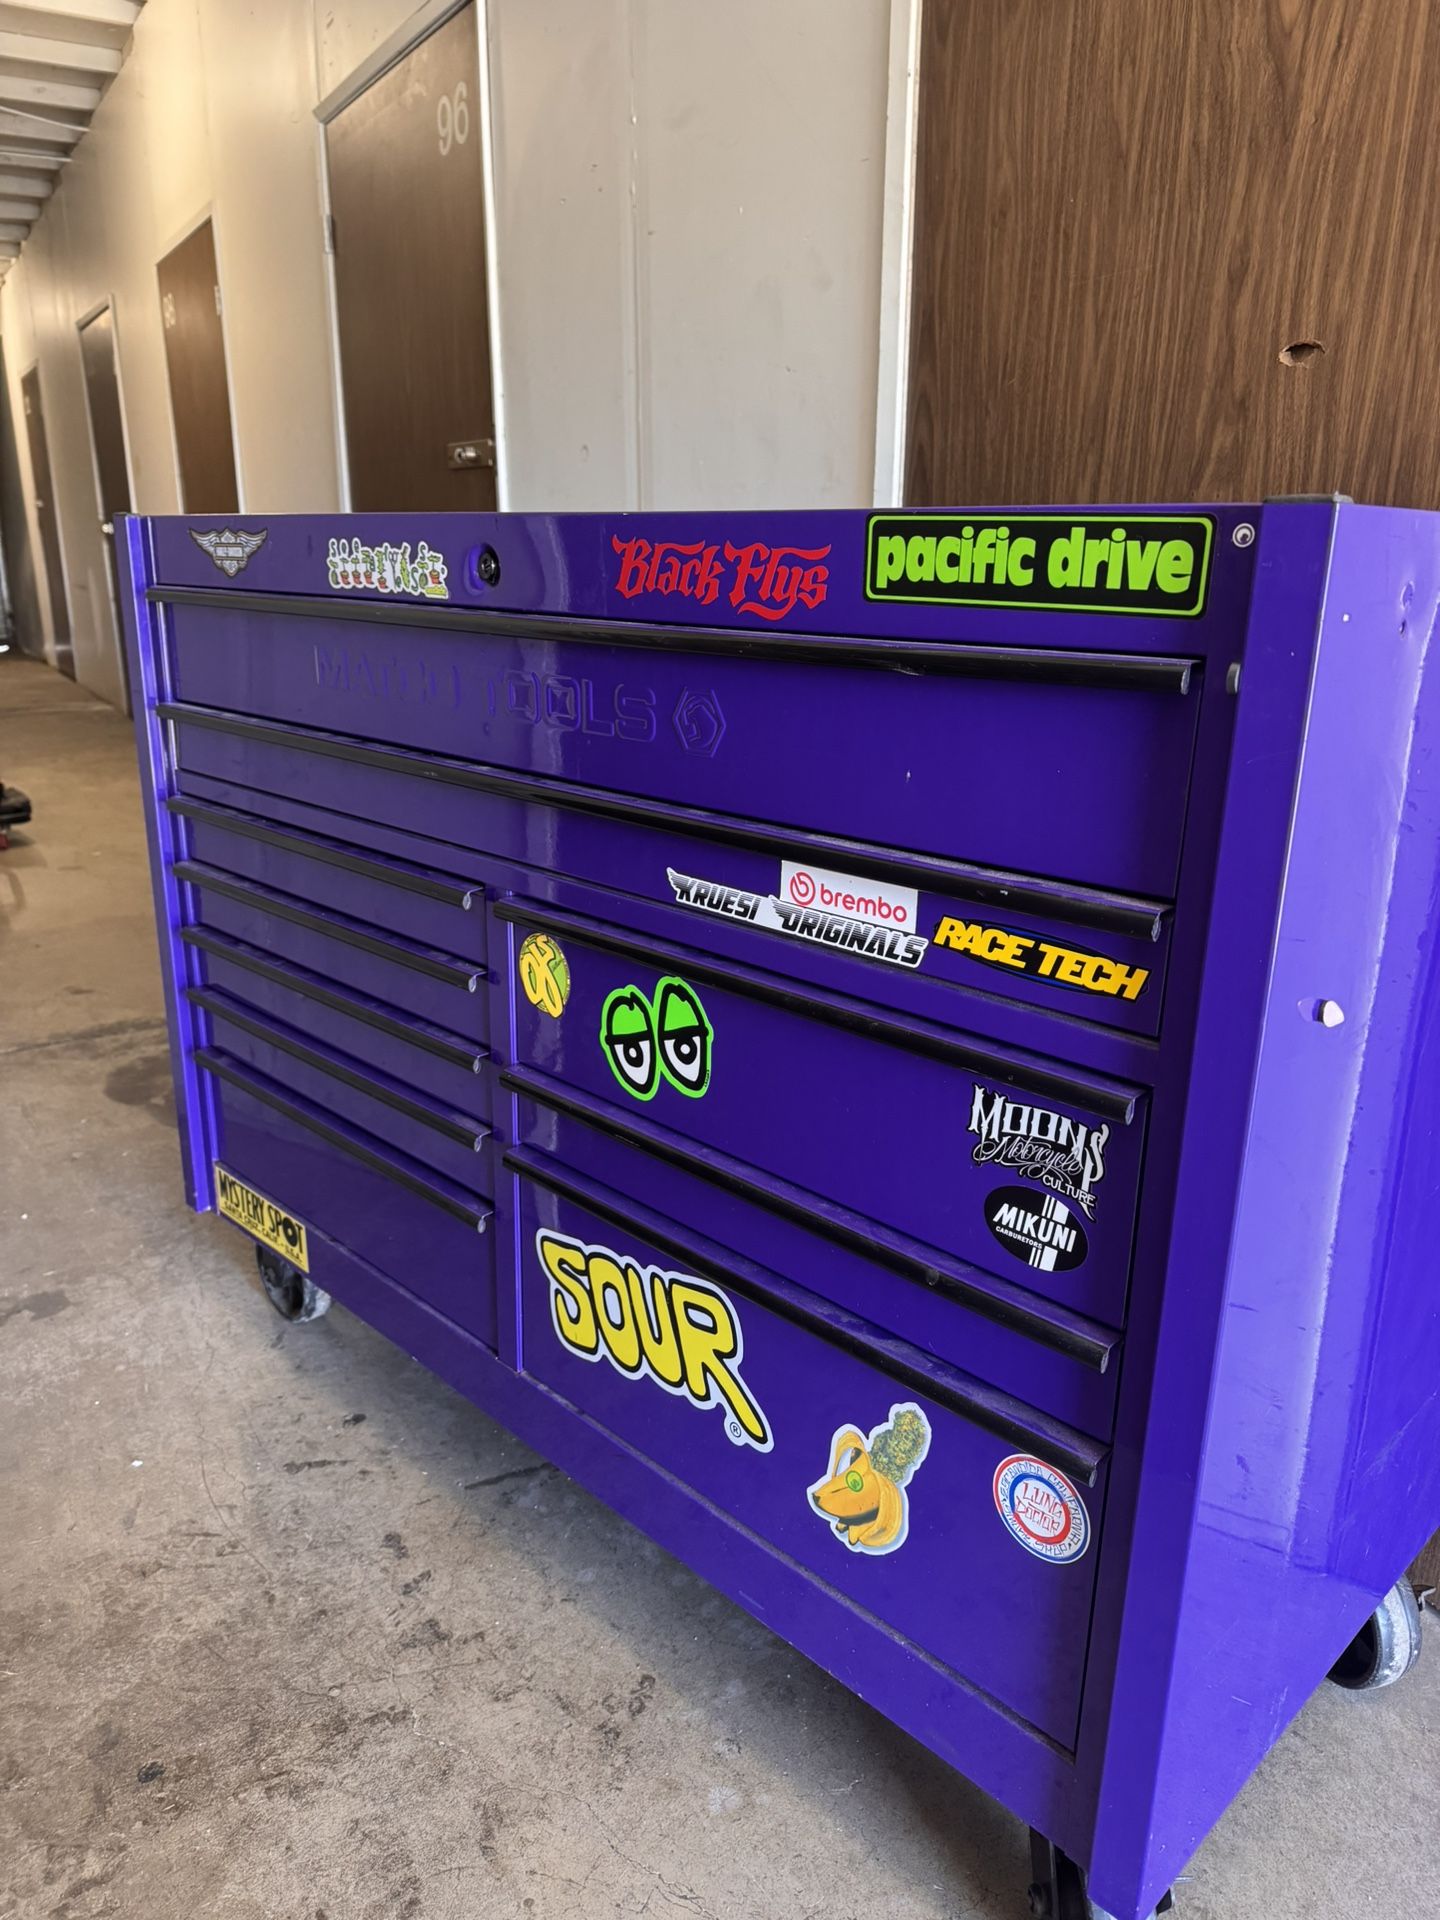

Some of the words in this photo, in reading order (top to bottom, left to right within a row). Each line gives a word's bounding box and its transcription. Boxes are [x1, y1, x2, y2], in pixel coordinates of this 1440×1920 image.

[437, 81, 469, 156] 96
[612, 534, 721, 606] Black
[722, 539, 832, 620] Flys
[877, 526, 1033, 588] pacific
[1048, 527, 1194, 594] drive
[671, 872, 762, 921] KRUESI
[771, 897, 928, 965] ORIGINALS
[819, 885, 908, 923] brembo
[932, 916, 1034, 969] RACE
[1037, 943, 1149, 1001] TECH
[218, 1170, 265, 1226] MYSTERY
[267, 1204, 303, 1254] SPOT
[1042, 1174, 1096, 1207] CULTURE
[992, 1202, 1077, 1253] MIKUNI
[995, 1225, 1043, 1249] CARBURETORS
[541, 1236, 768, 1444] SOUR
[1015, 1495, 1060, 1537] DOCTOR
[1022, 1482, 1063, 1519] LUNG
